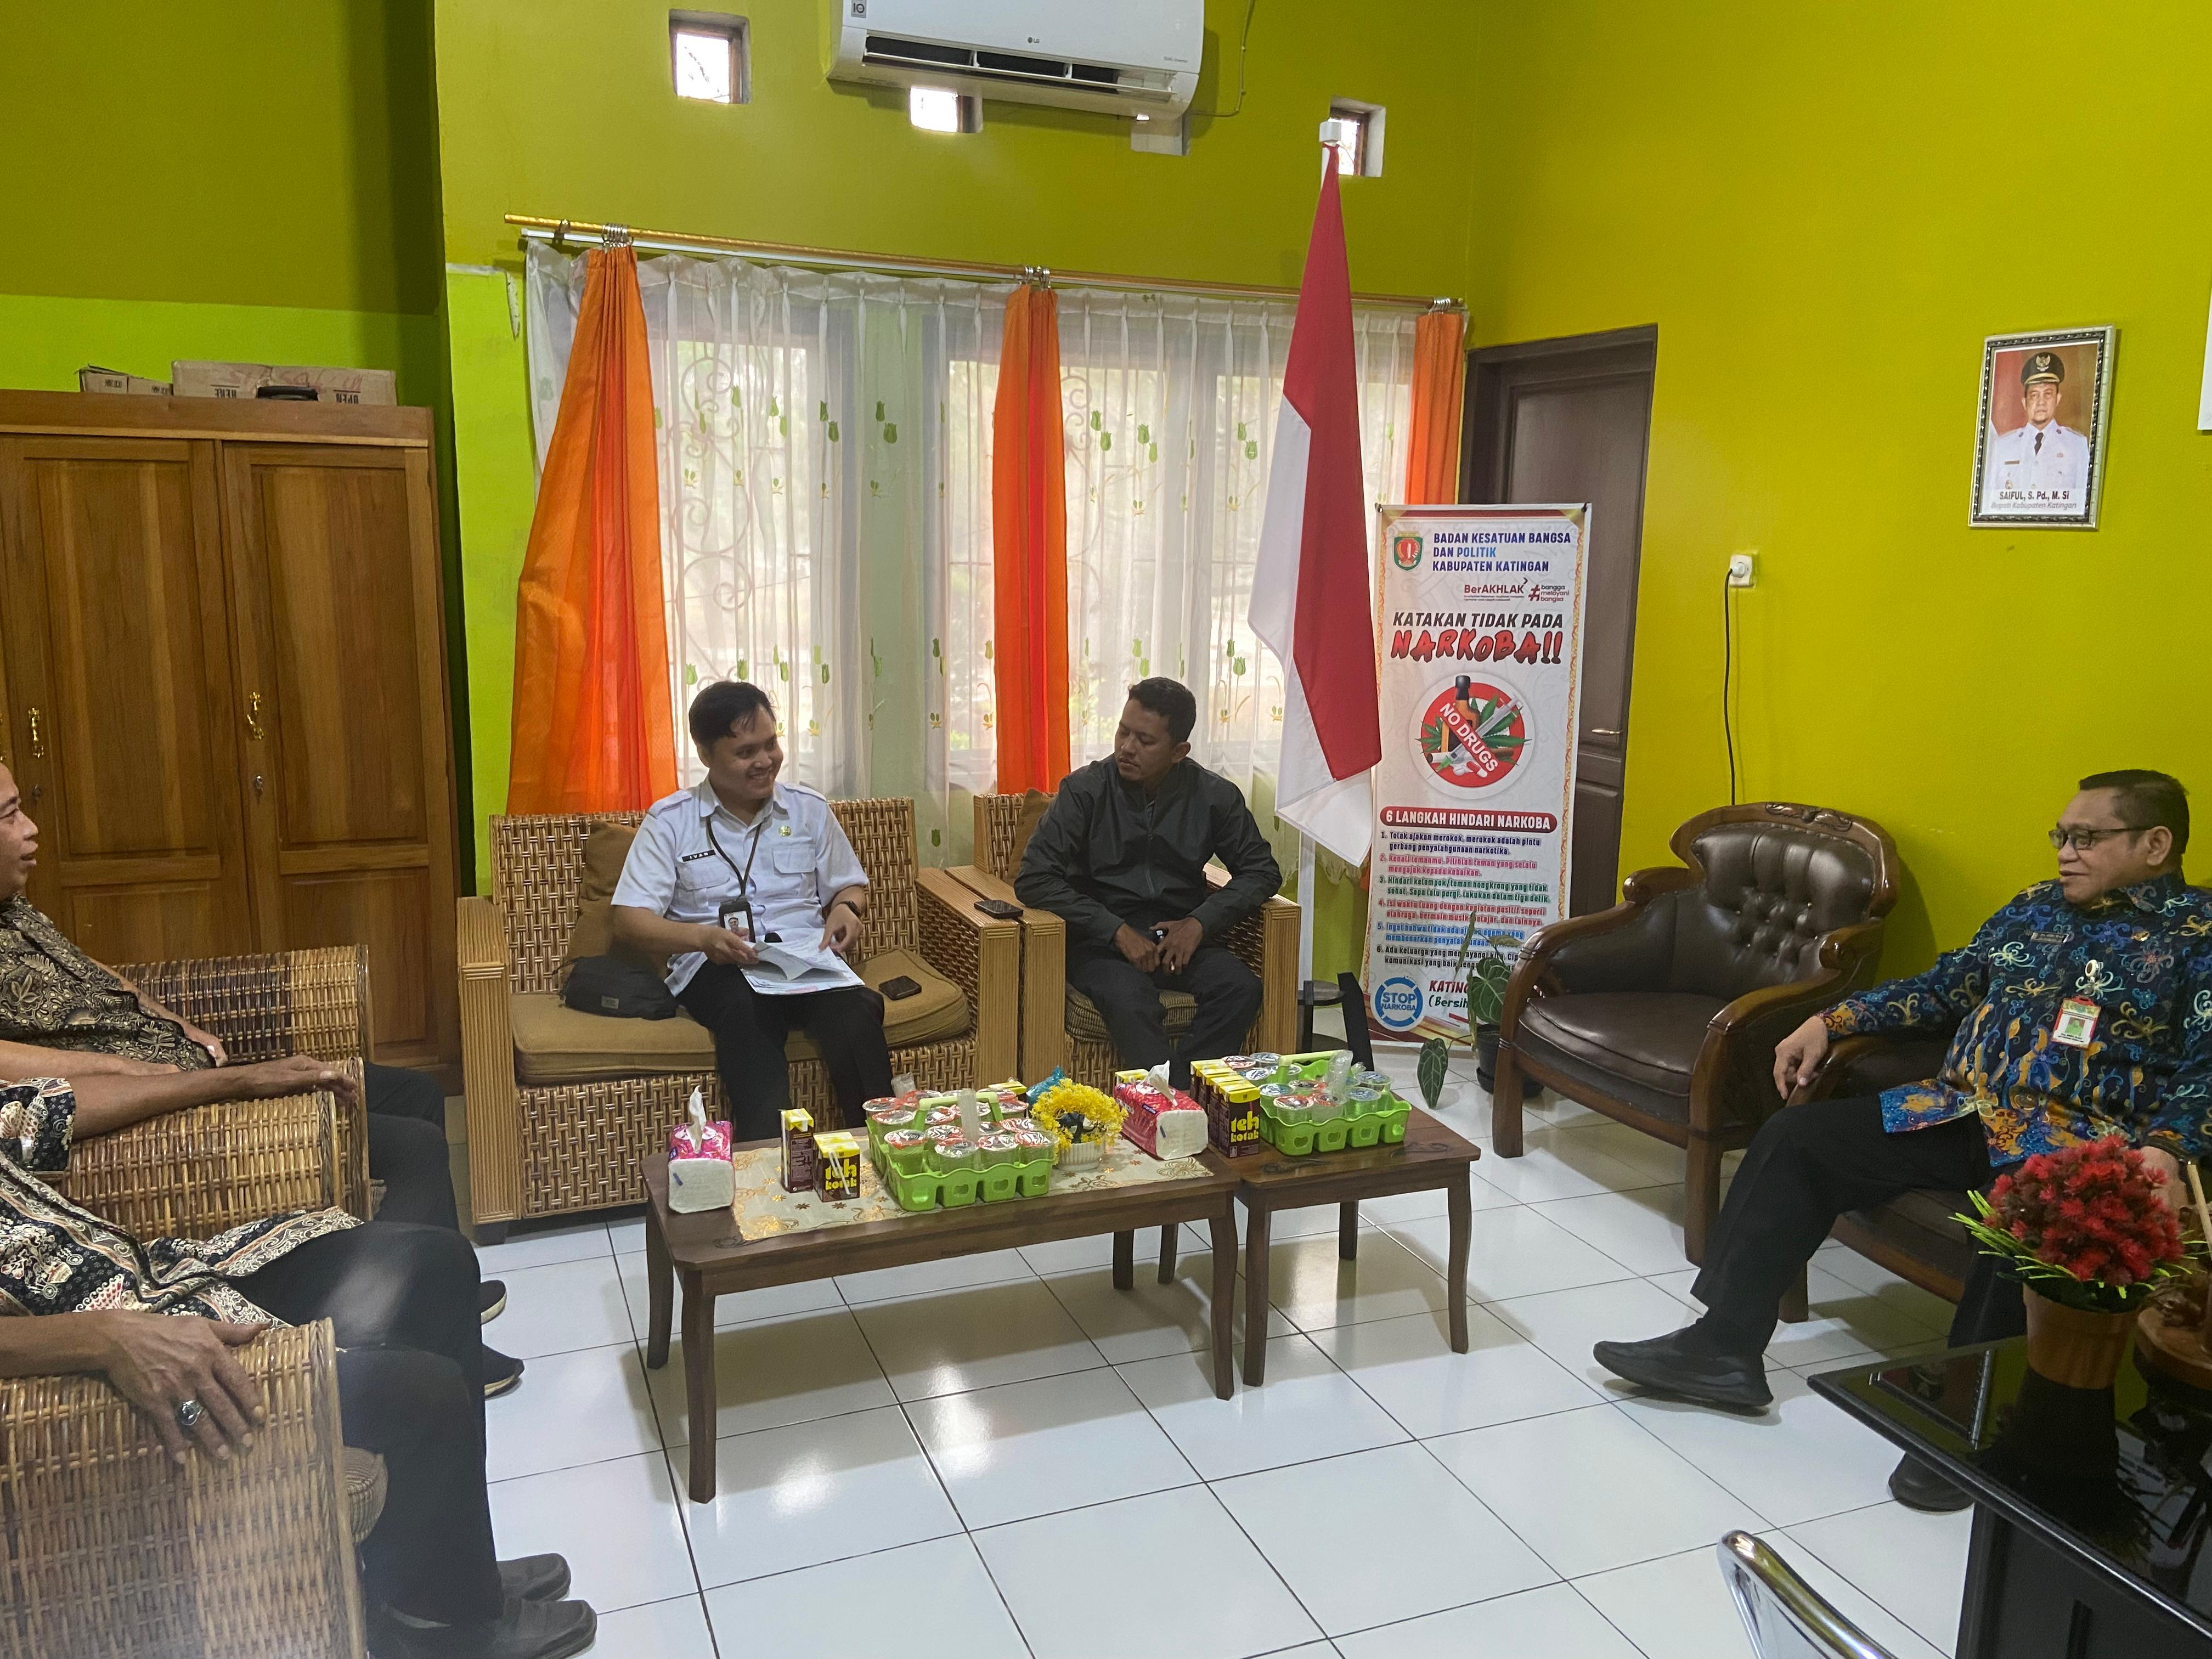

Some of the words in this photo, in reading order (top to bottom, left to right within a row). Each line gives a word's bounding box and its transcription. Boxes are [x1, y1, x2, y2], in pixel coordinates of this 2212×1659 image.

[2000, 491, 2025, 501] SAIFUL,
[2028, 491, 2034, 500] S.
[2052, 491, 2059, 500] M.
[2062, 490, 2069, 500] Si
[1991, 502, 2011, 510] Bupati
[2012, 502, 2046, 510] Kabupaten
[2047, 502, 2076, 510] Katingan
[1434, 533, 1468, 544] BADAN
[1471, 533, 1525, 544] KESATUAN
[1528, 533, 1571, 544] BANGSA
[1433, 547, 1454, 557] DAN
[1457, 547, 1497, 557] POLITIK
[1432, 561, 1492, 572] KABUPATEN
[1496, 561, 1549, 572] KATINGAN
[1464, 584, 1524, 594] BerAKHLAK
[1393, 612, 1466, 627] KATAKAN
[1471, 613, 1519, 628] TIDAK
[1521, 613, 1562, 628] PADA
[1440, 703, 1460, 726] NO
[1456, 724, 1499, 772] DRUGS
[1386, 810, 1393, 822] 6
[1396, 810, 1447, 825] LANGKAH
[1449, 812, 1494, 827] HINDARI
[1497, 815, 1550, 830] NARKOBA
[1409, 832, 1431, 841] ajakan
[1522, 838, 1540, 847] pintu
[1390, 843, 1416, 851] gerbang
[1418, 844, 1472, 854] penyalahgunaan
[1446, 856, 1472, 865] Pilihlah
[1496, 861, 1513, 870] yang
[1389, 865, 1421, 875] mengajak
[1422, 867, 1446, 876] kepada
[1414, 878, 1471, 888] kelompok/teman
[1473, 882, 1509, 890] nongkrong
[1510, 883, 1527, 892] yang
[1529, 884, 1548, 892] tidak
[1409, 888, 1425, 897] Sapa
[1463, 891, 1490, 899] lakukan
[1492, 893, 1513, 901] dalam
[1515, 894, 1528, 902] tiga
[1419, 901, 1438, 911] luang
[1440, 903, 1464, 912] dengan
[1497, 906, 1519, 914] positif
[1521, 907, 1545, 916] seperti
[1386, 923, 1403, 932] Ingat
[1386, 934, 1431, 943] membenarkan
[1434, 936, 1488, 946] penyalahunaan
[1400, 947, 1428, 956] keluarga
[1430, 949, 1446, 957] yang
[1448, 950, 1488, 959] menayangi
[1385, 956, 1423, 966] komunikasi
[1443, 960, 1457, 968] baik
[1383, 992, 1416, 1004] STOP
[1231, 1110, 1259, 1132] teh
[1231, 1130, 1259, 1142] kotak
